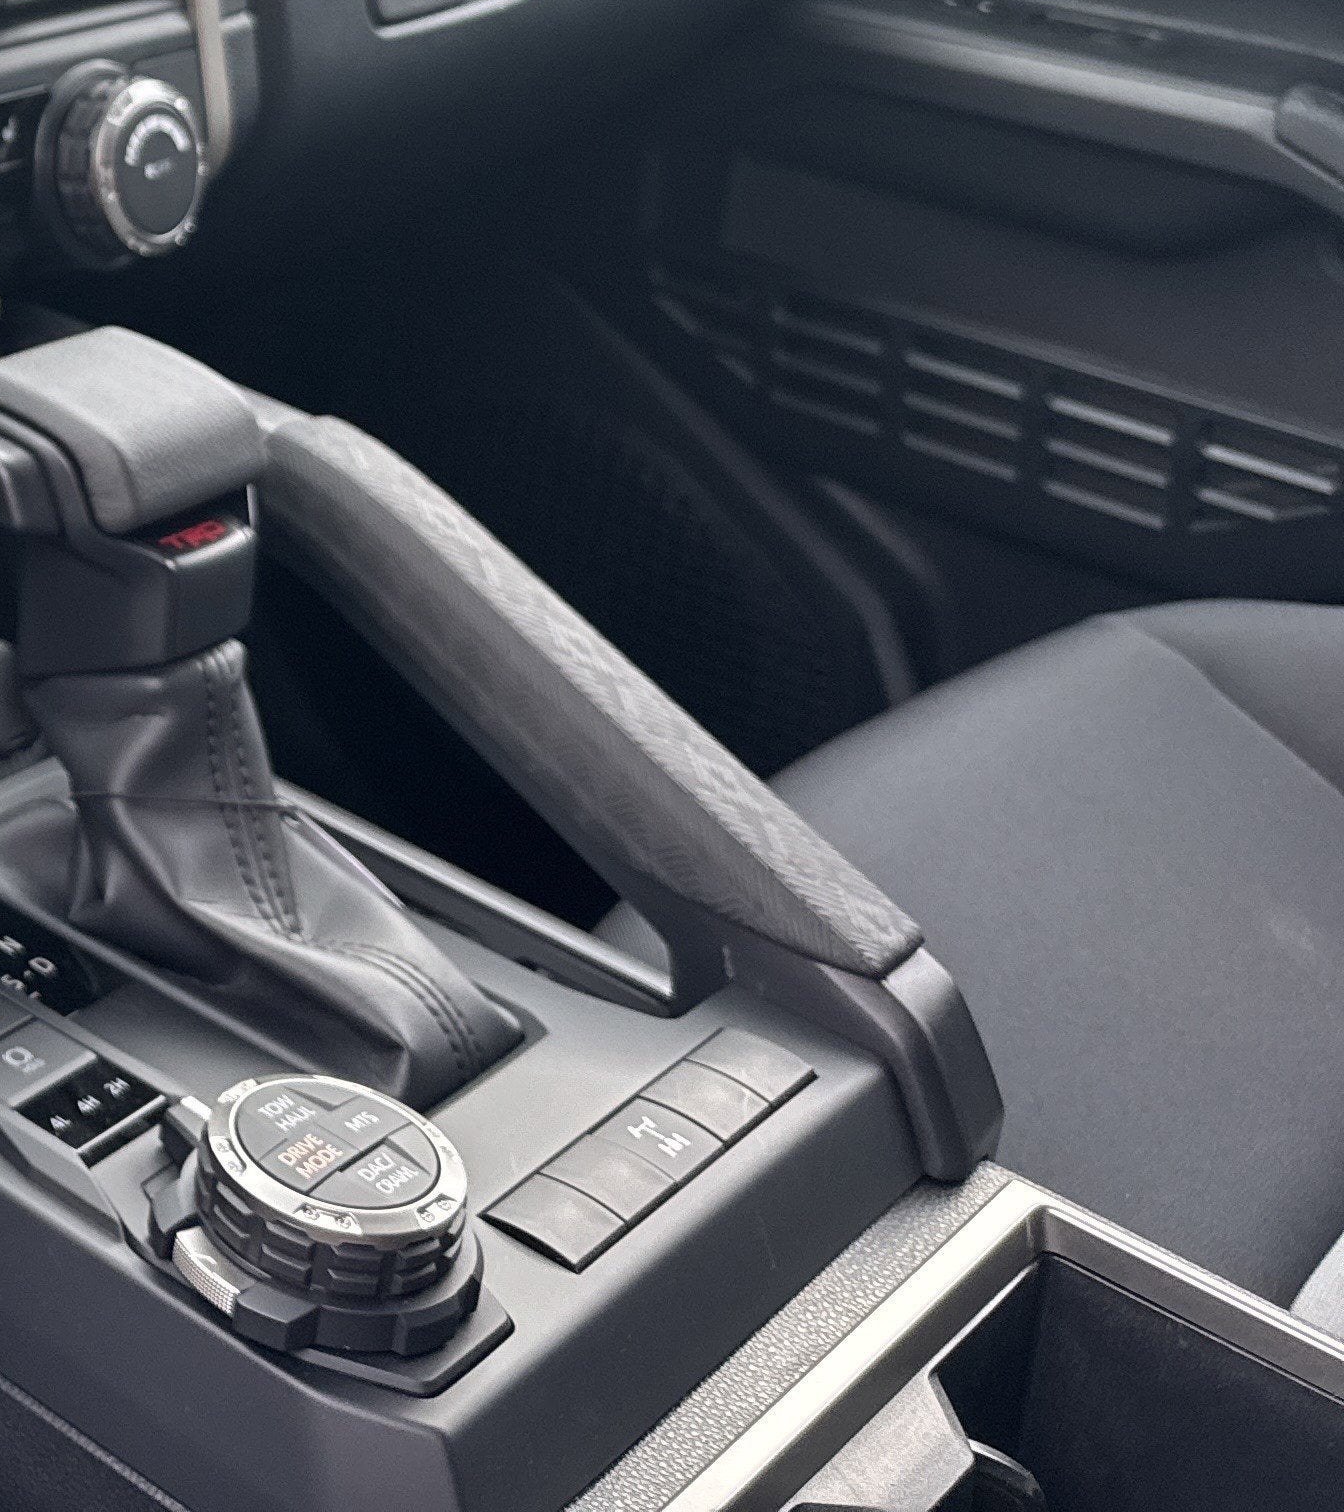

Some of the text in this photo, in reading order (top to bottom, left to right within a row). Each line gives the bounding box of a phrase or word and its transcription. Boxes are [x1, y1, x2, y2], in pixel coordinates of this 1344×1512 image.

[157, 520, 226, 549] TRD
[28, 956, 58, 977] D
[77, 1094, 101, 1115] 4H
[257, 1094, 295, 1119] TOW
[50, 1115, 72, 1132] 4L
[275, 1105, 317, 1133] HAUL
[344, 1110, 380, 1133] MTS
[277, 1133, 325, 1167] DRIVE
[296, 1143, 344, 1180] MODE
[357, 1152, 397, 1182] DAC/
[375, 1167, 420, 1194] CRAWL
